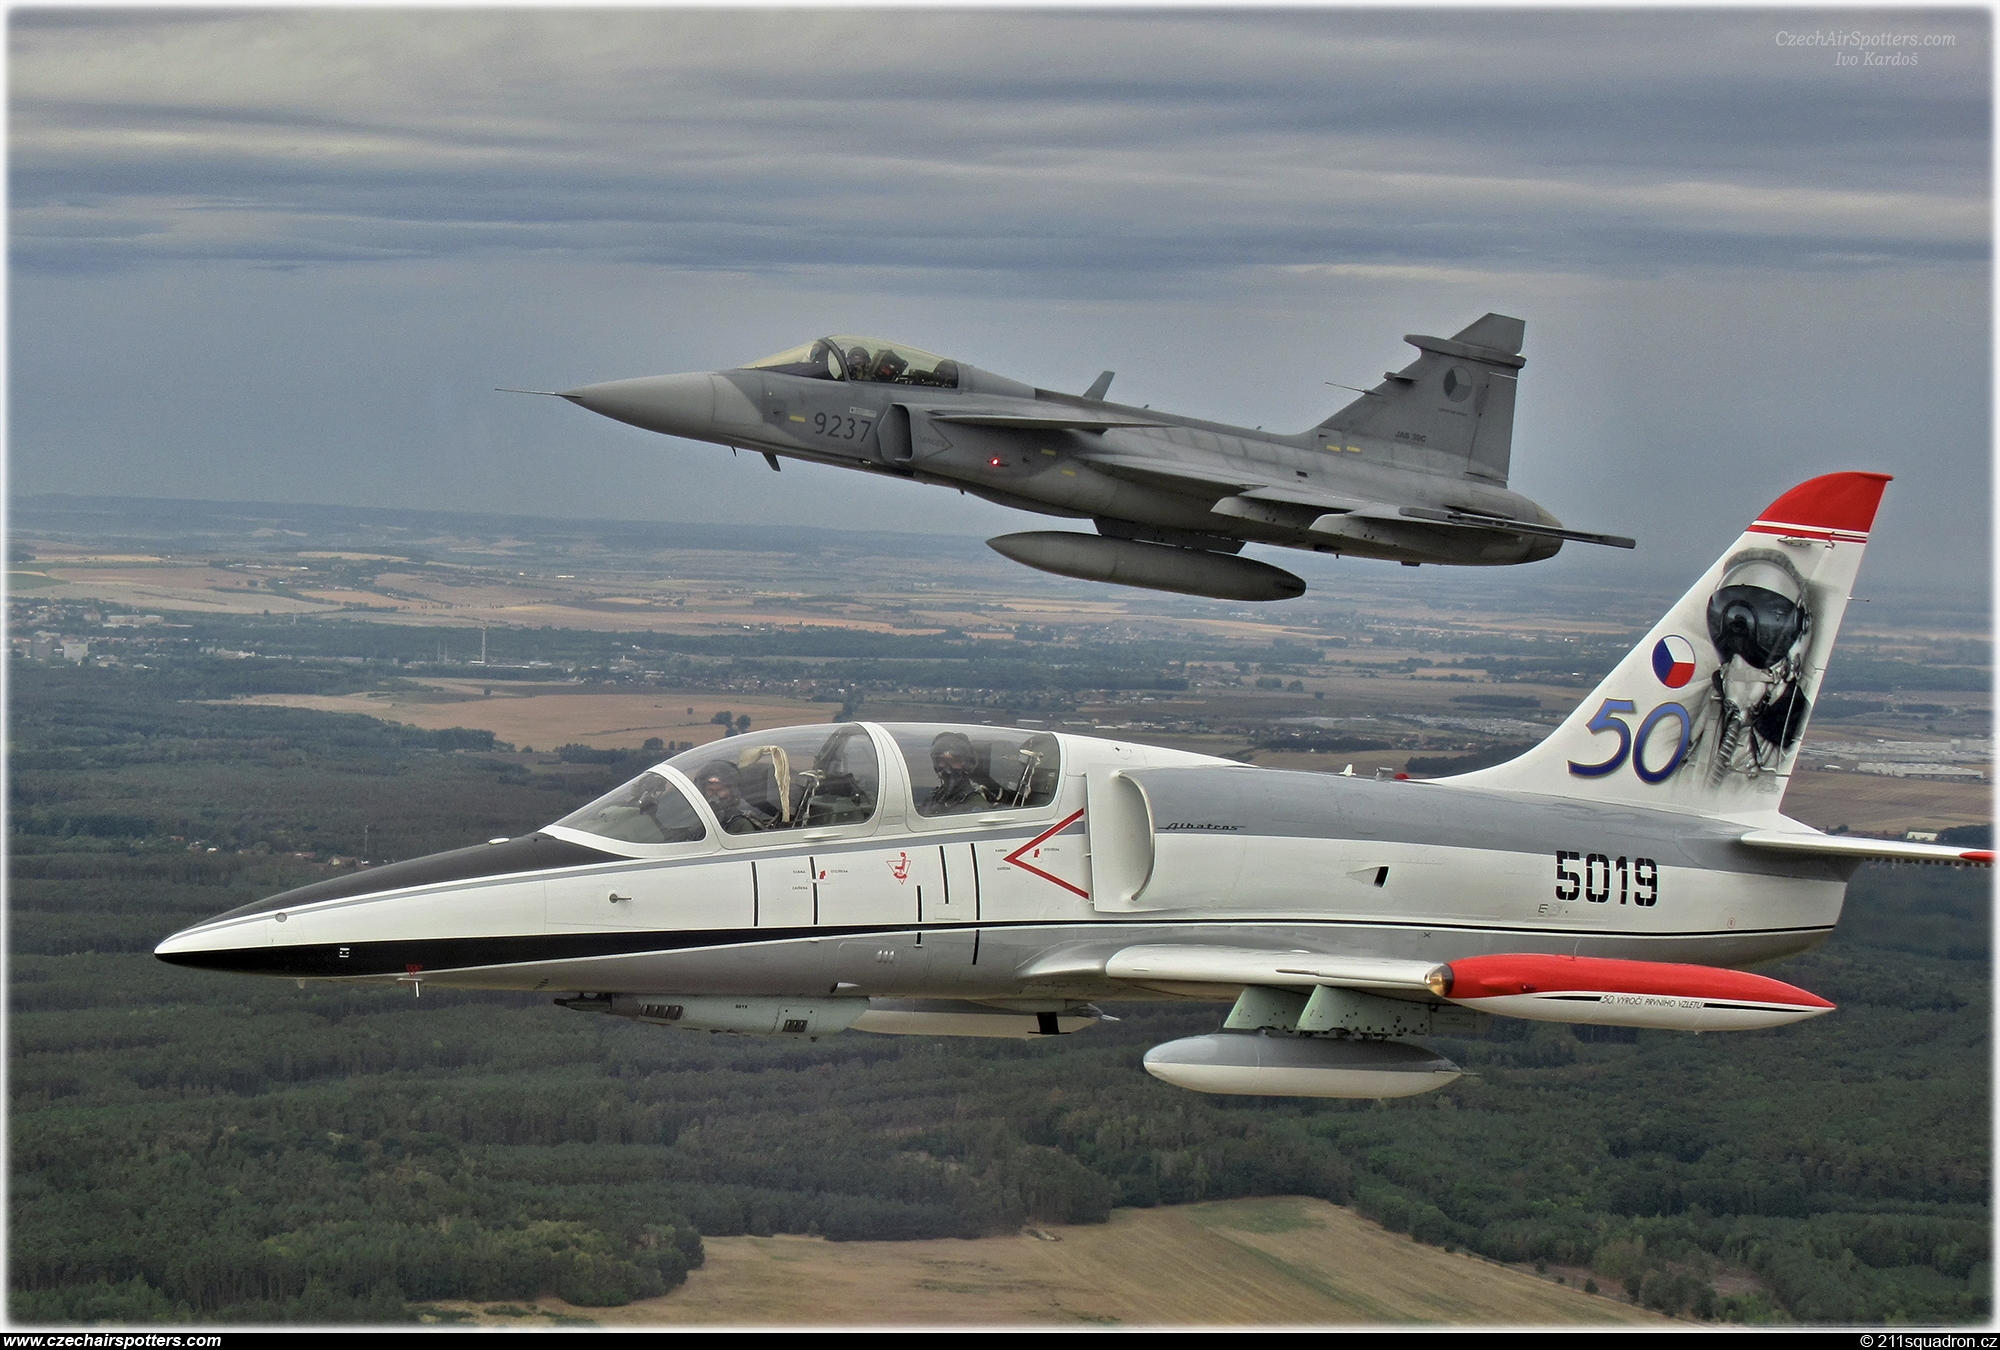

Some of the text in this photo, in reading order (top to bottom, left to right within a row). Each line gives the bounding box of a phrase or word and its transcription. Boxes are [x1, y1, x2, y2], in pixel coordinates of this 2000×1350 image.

[814, 412, 871, 442] 9237
[1566, 697, 1691, 785] 50
[1158, 822, 1241, 831] Albatros
[1556, 850, 1658, 907] 5019
[1677, 1000, 1704, 1009] VZLETU
